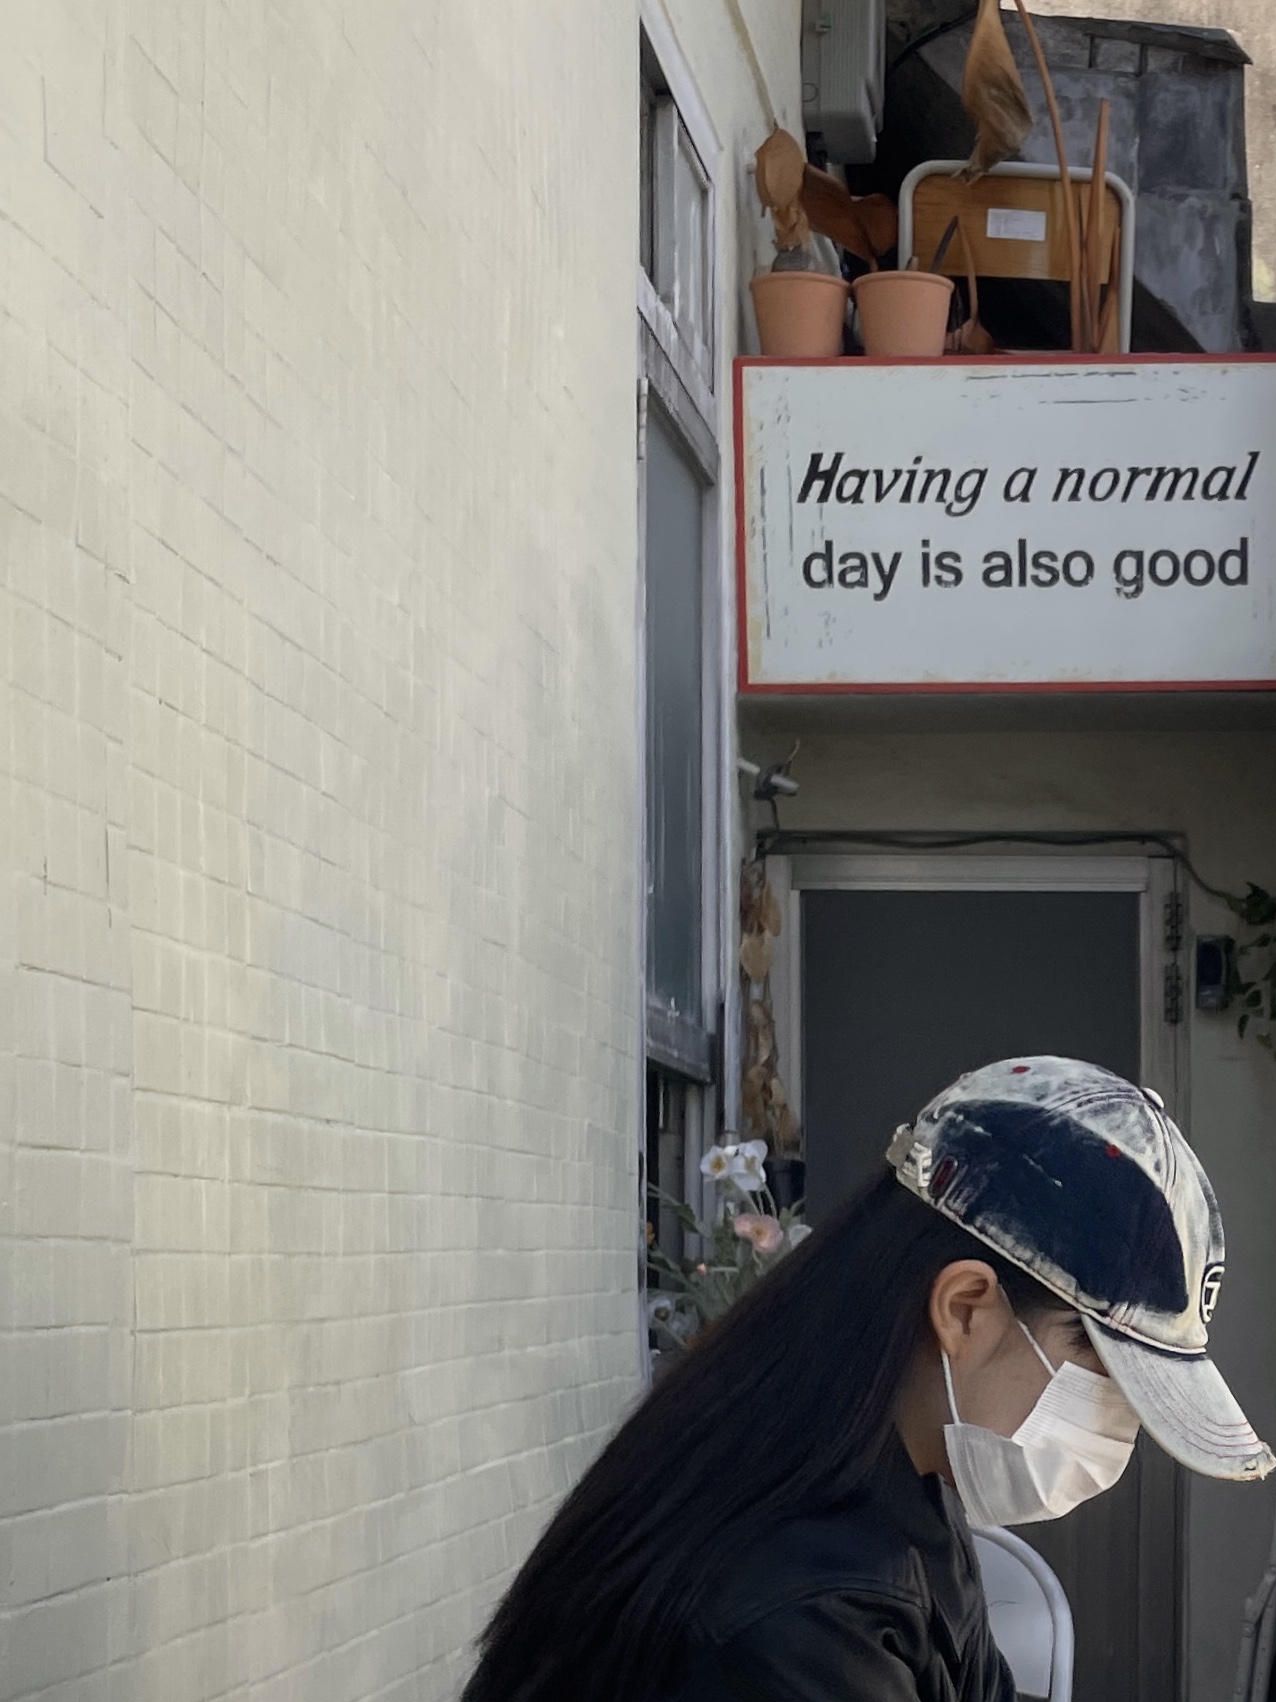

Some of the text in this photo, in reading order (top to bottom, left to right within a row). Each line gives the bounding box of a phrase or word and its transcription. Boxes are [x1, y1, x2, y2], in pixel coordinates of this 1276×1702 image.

[797, 451, 1260, 517] Having a normal
[802, 537, 1248, 601] day is also good
